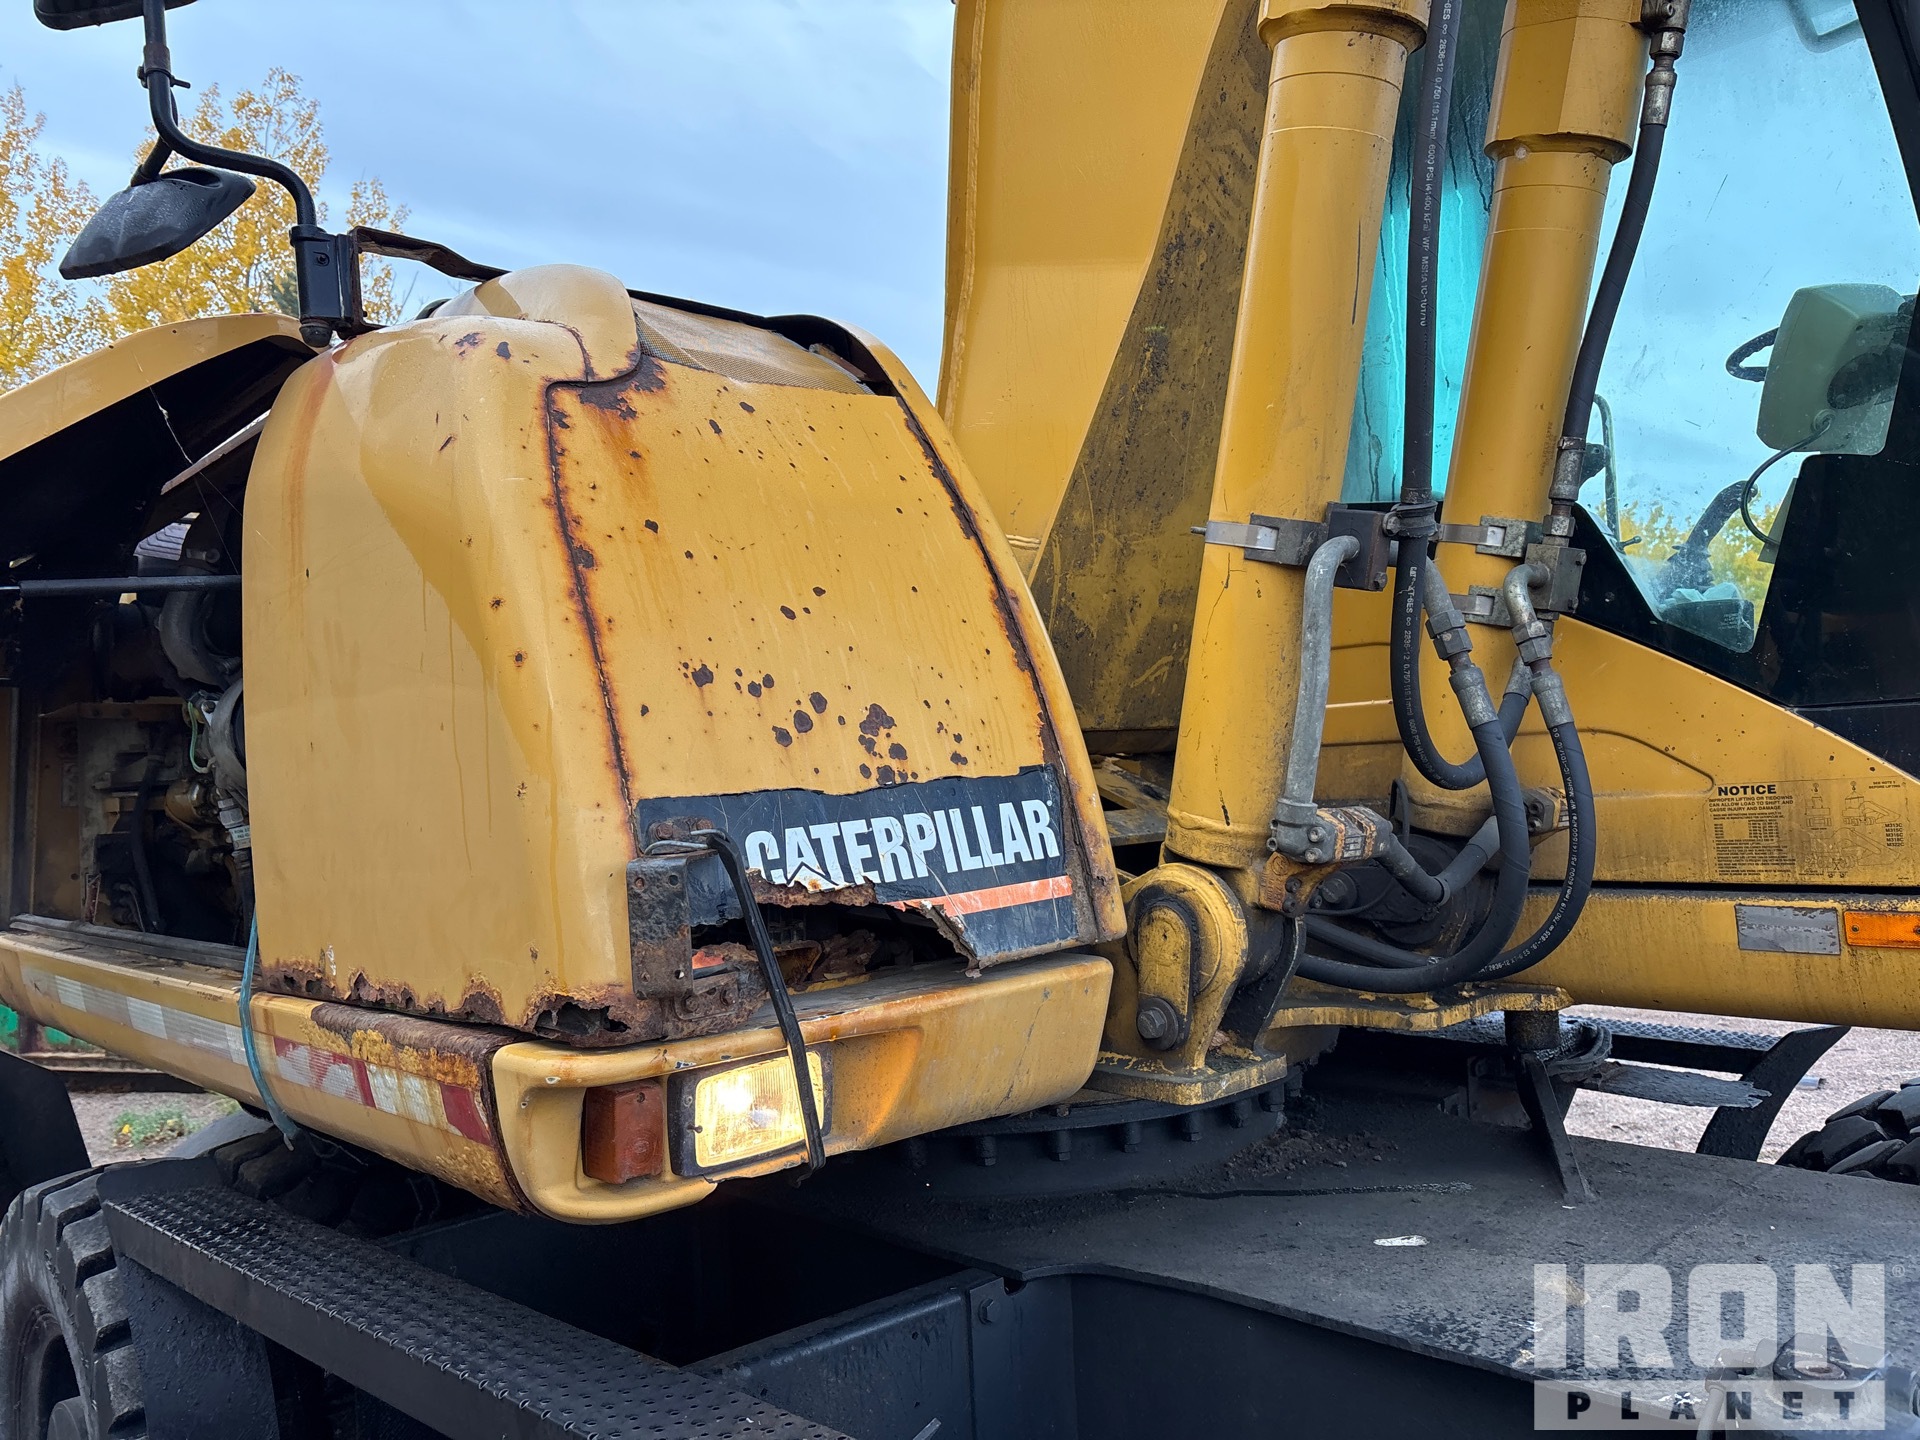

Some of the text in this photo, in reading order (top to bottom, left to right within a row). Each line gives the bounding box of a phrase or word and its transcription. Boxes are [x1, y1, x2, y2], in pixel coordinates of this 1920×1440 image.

[1436, 39, 1447, 72] 2836-12
[1566, 776, 1575, 797] MSHA
[1717, 784, 1777, 796] NOTICE
[1569, 799, 1577, 810] WP
[745, 799, 1060, 893] CATERPILLAR
